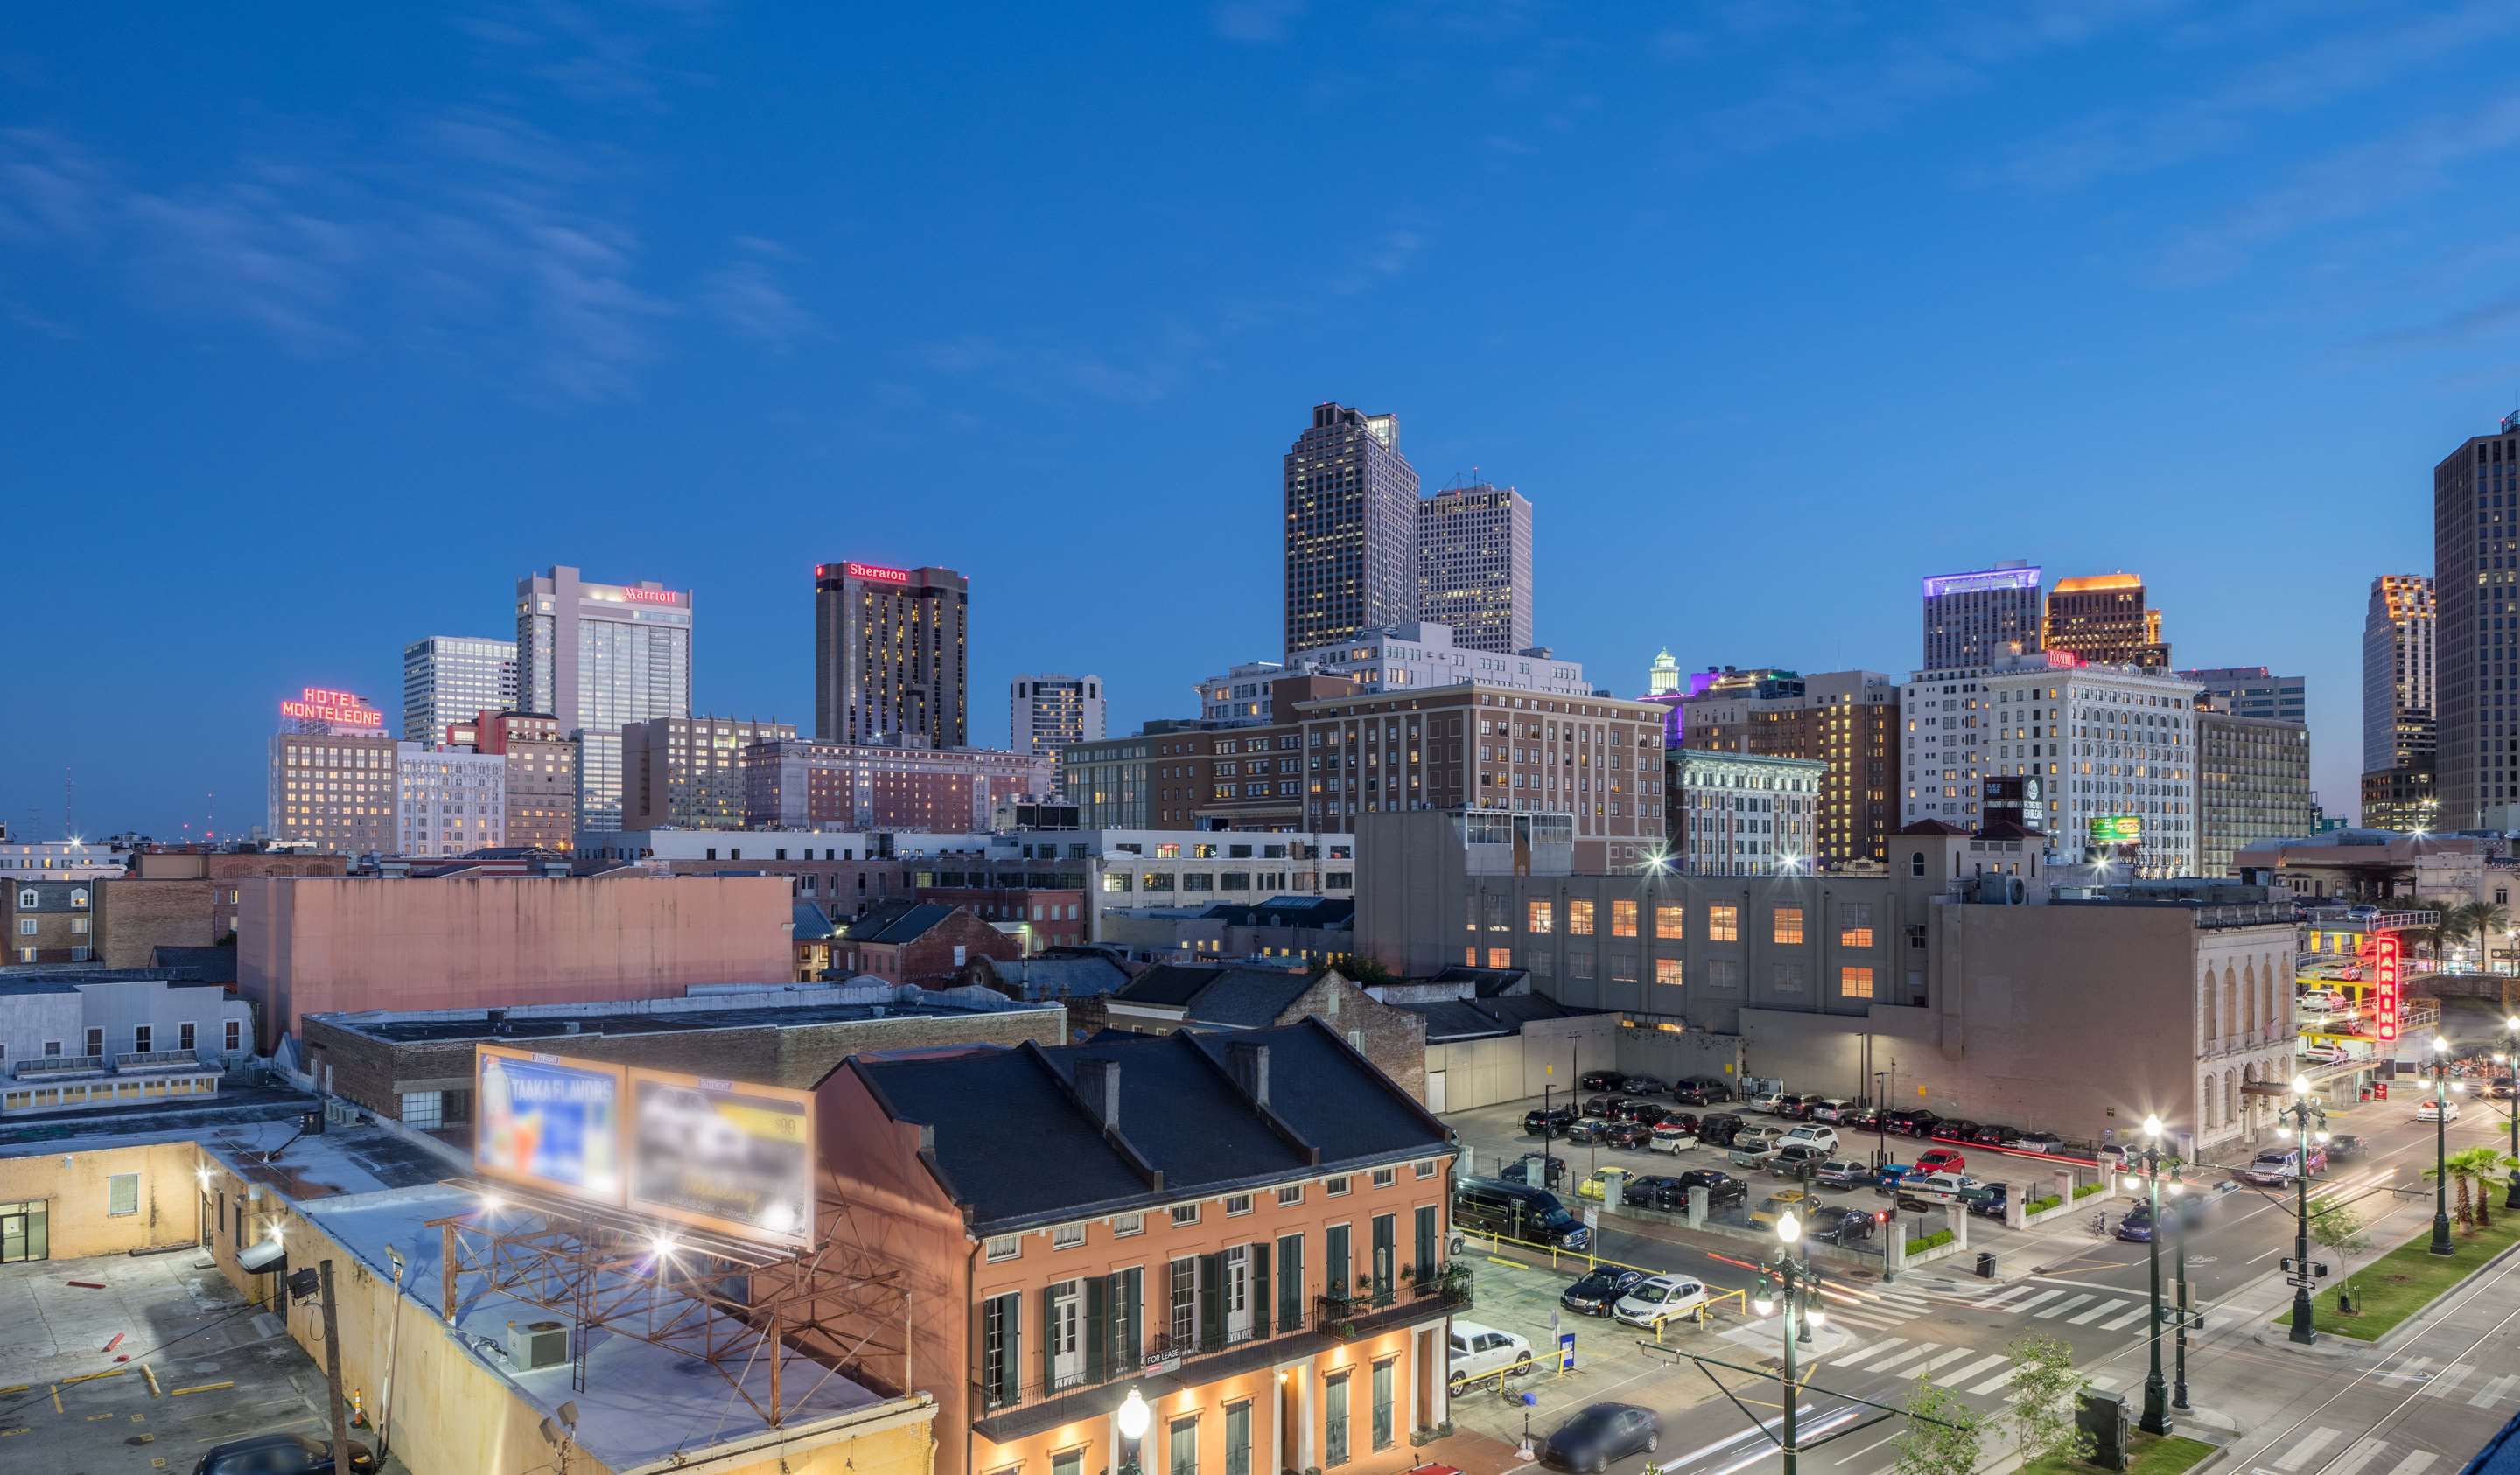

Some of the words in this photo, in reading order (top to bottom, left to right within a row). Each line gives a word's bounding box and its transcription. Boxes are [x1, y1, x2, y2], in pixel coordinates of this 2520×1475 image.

[850, 563, 906, 581] Sheraton
[622, 587, 676, 603] Marriott
[304, 688, 360, 708] HOTEL
[283, 701, 382, 725] MONTELEONE
[2381, 942, 2394, 1037] PARKING
[512, 1079, 550, 1101] TAAKA
[552, 1079, 612, 1101] FLAVORS
[1147, 1354, 1160, 1364] FOR
[1161, 1348, 1179, 1360] LEASE
